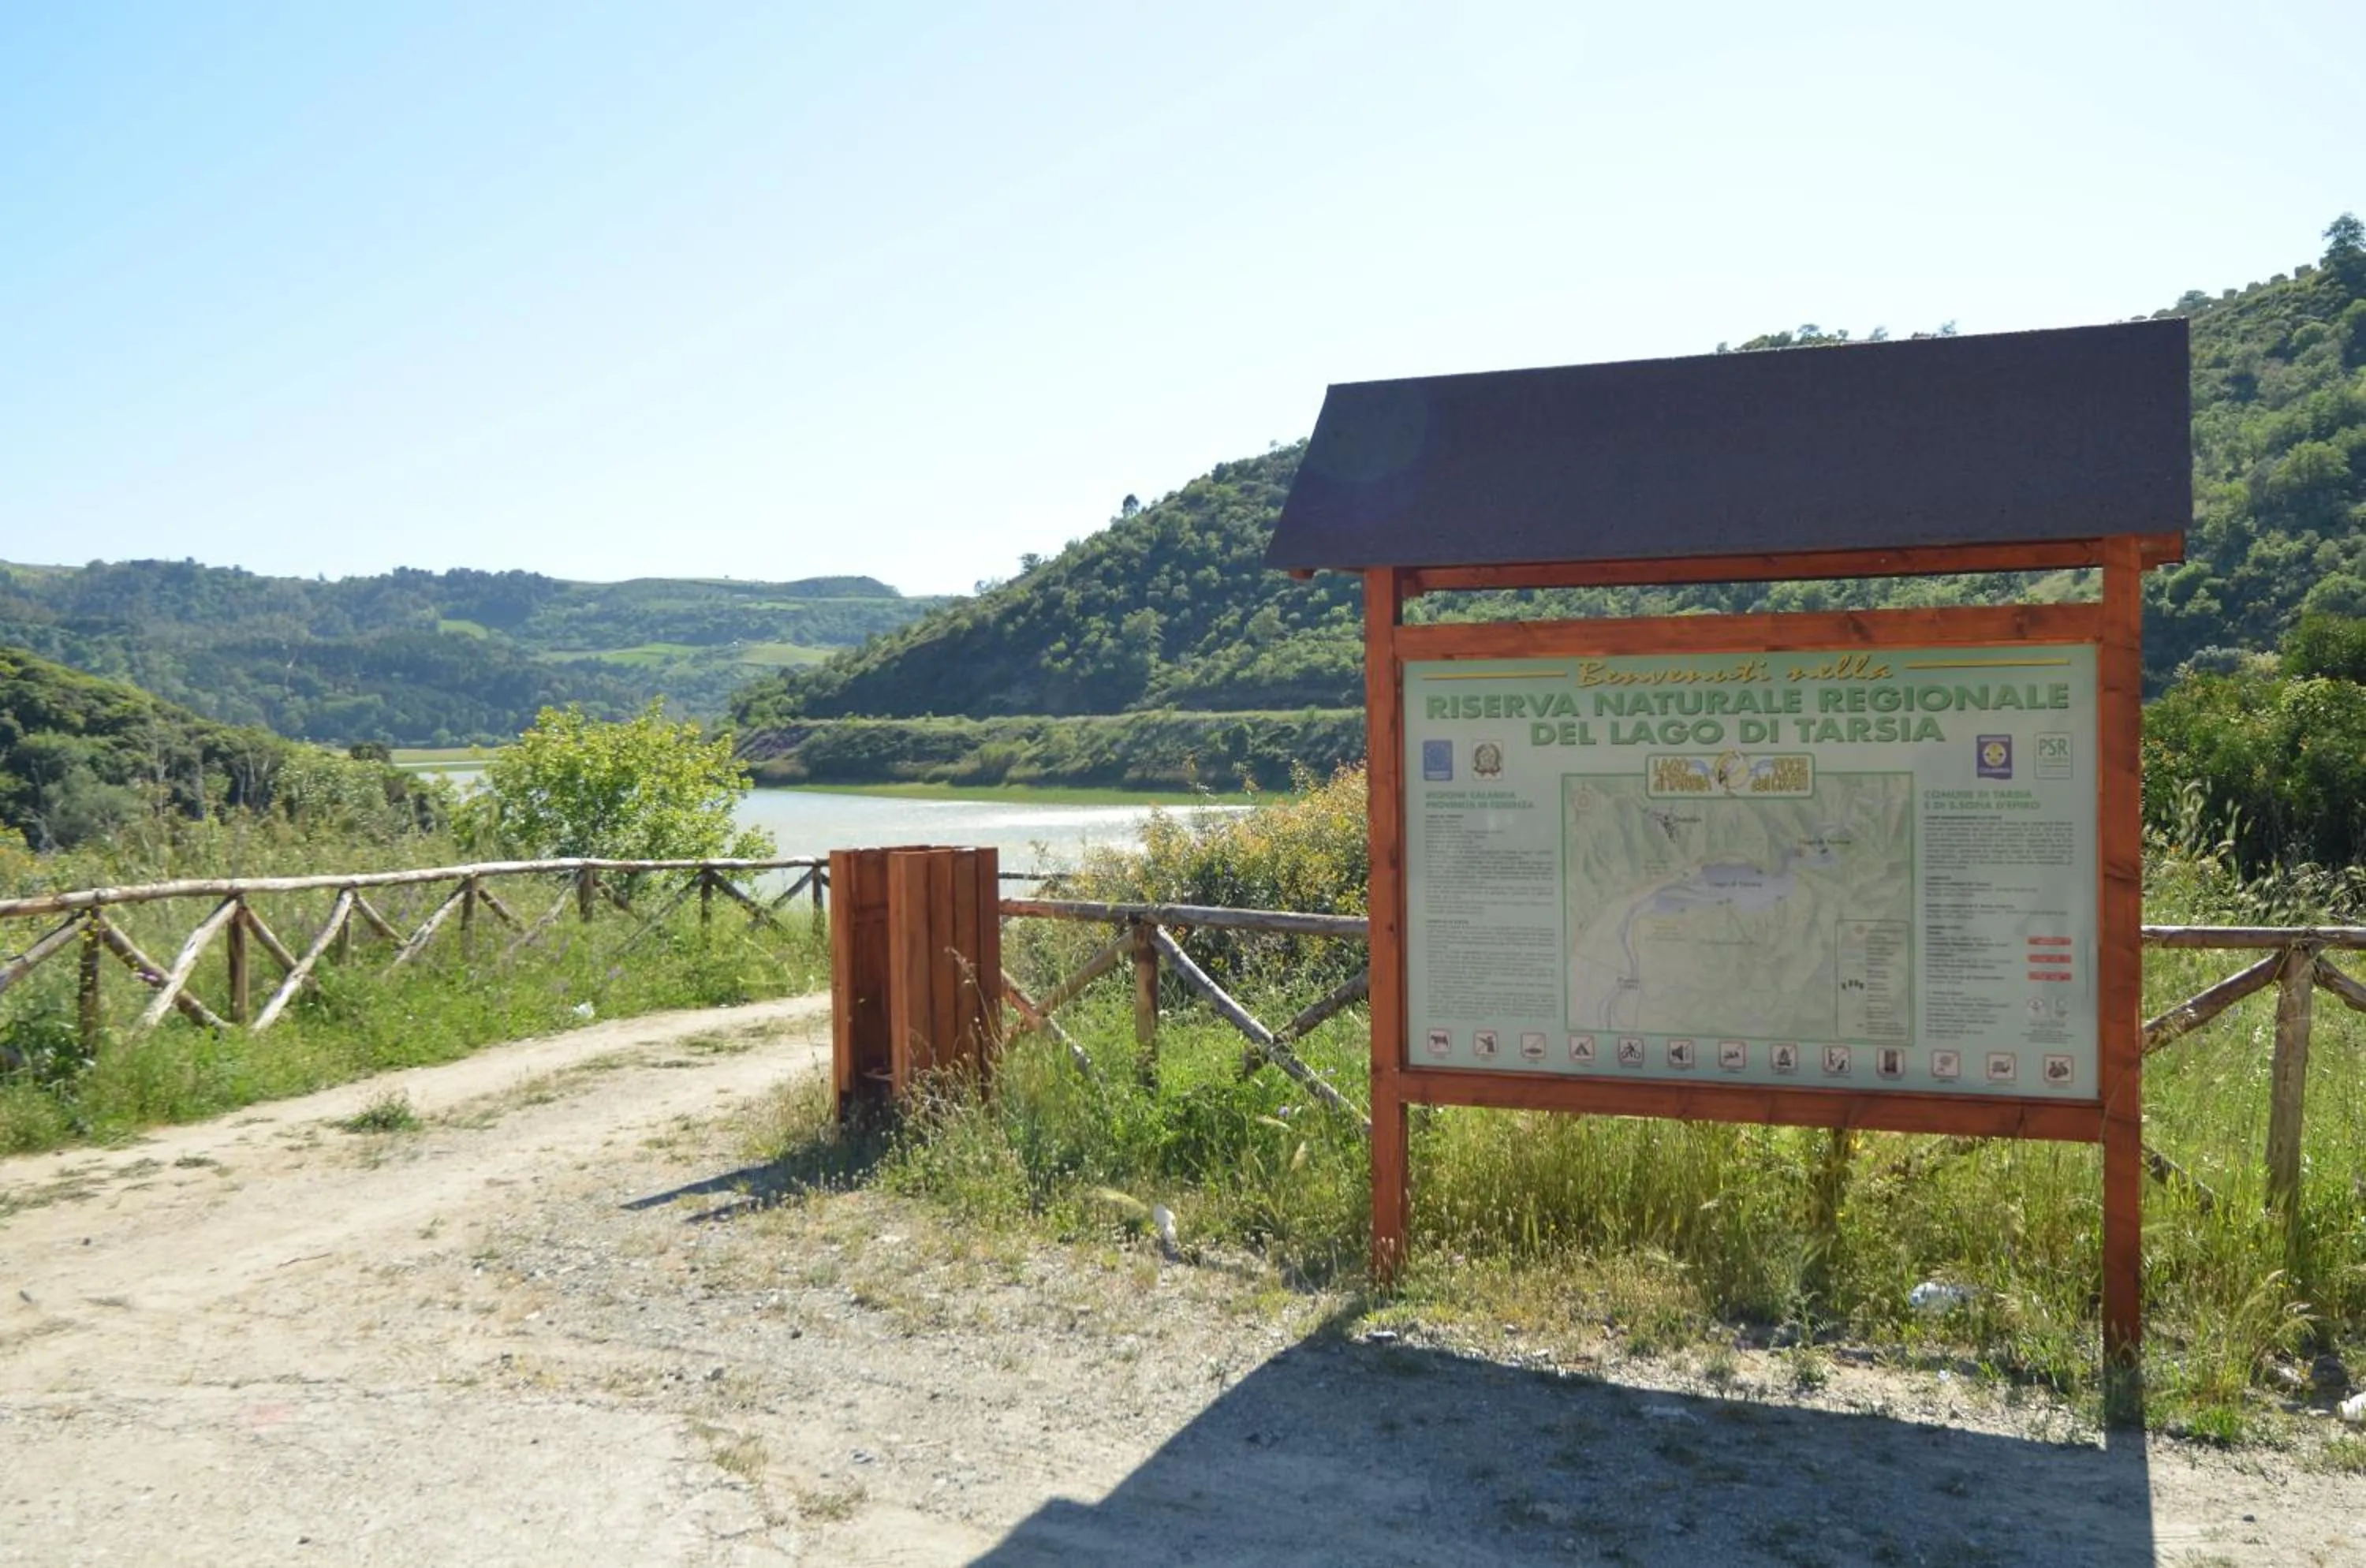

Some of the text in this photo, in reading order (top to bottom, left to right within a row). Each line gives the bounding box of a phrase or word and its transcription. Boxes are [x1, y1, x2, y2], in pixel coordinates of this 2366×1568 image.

[1577, 655, 1894, 689] Benvenuti nella
[1426, 682, 2070, 719] RISERVA NATURALE REGIONALE
[1531, 716, 1946, 746] DEL LAGO DI TARSIA
[2038, 738, 2069, 757] PSR
